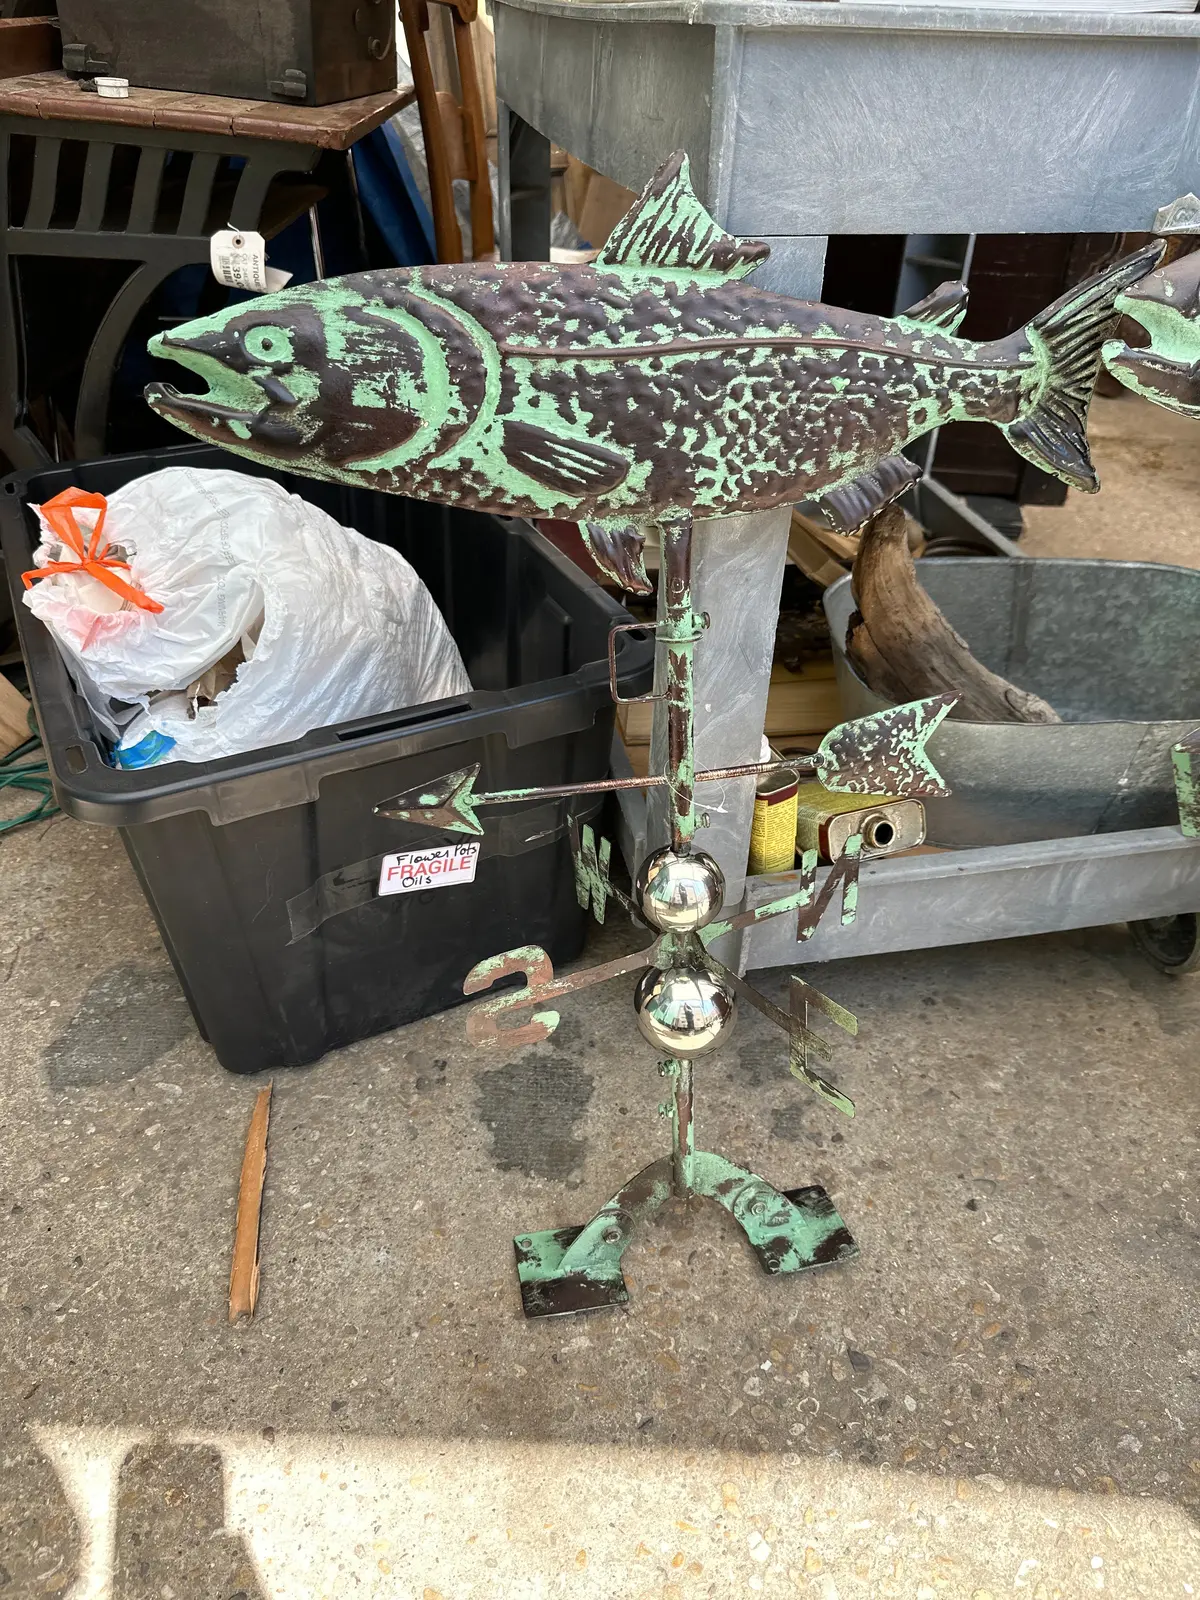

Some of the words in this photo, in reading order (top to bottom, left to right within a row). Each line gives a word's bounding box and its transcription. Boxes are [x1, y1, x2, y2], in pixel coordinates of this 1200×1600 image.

[252, 254, 260, 288] ANTIQUE
[396, 849, 449, 866] Flower
[454, 843, 478, 857] Pots
[387, 855, 473, 881] FRAGILE
[402, 875, 432, 888] Oils
[789, 974, 859, 1119] E
